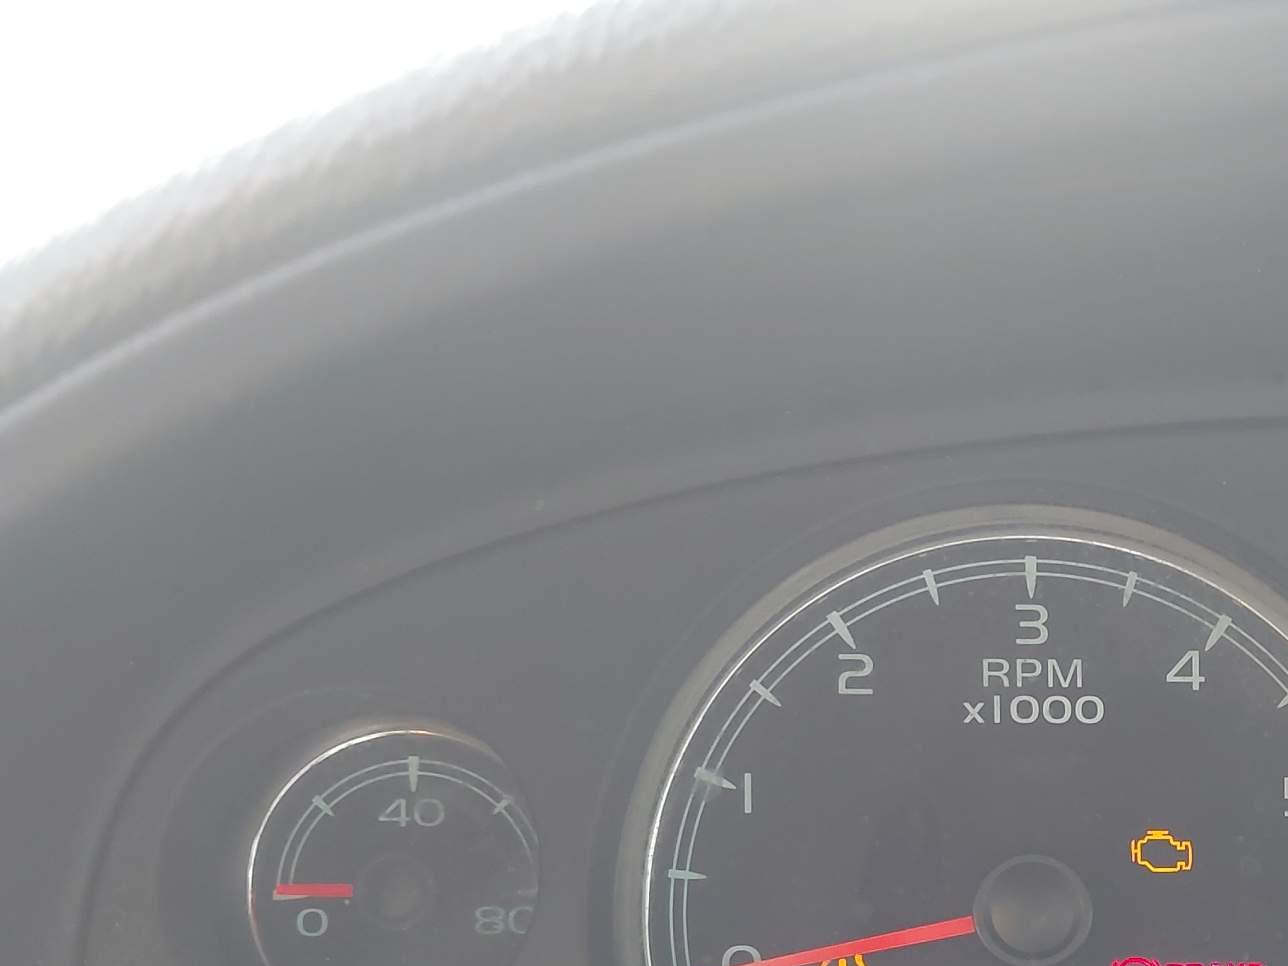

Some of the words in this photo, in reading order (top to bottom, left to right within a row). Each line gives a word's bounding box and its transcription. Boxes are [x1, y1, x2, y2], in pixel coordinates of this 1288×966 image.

[1015, 604, 1049, 645] 3
[837, 653, 874, 695] 2
[982, 658, 1083, 688] RPM
[1166, 651, 1206, 691] 4
[963, 695, 1104, 724] x1000
[744, 772, 752, 814] 1
[378, 798, 445, 827] 40
[296, 908, 329, 937] 0
